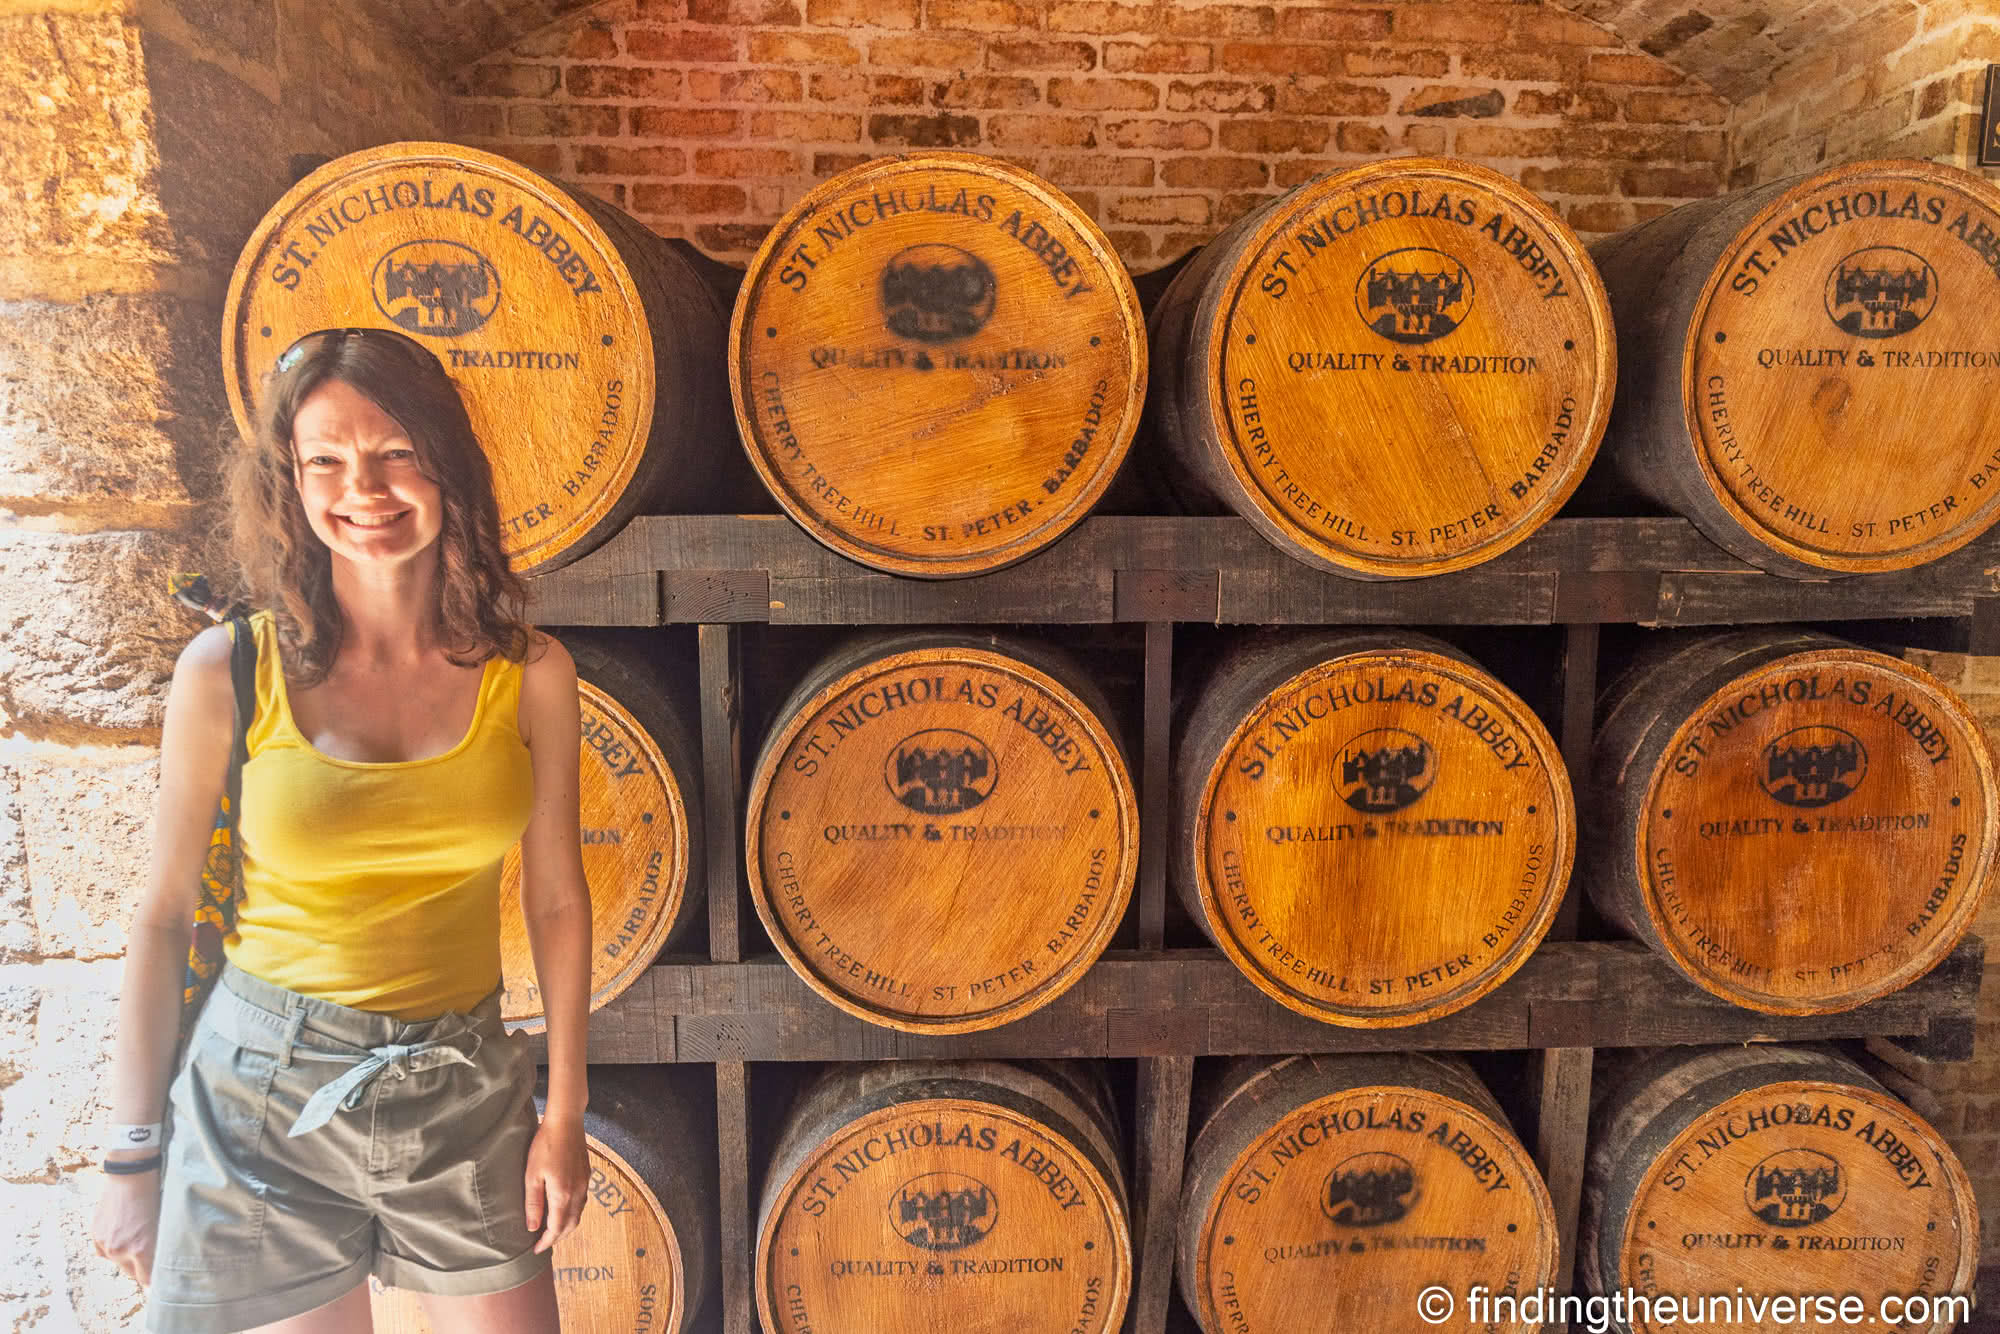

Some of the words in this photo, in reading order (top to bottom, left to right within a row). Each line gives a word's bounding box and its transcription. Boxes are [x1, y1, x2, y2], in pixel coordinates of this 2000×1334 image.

[271, 239, 317, 292] ST.
[306, 180, 496, 247] NICHOLAS
[500, 205, 603, 298] ABBEY
[815, 185, 996, 252] NICHOLAS
[1000, 210, 1096, 299] ABBEY
[1301, 192, 1476, 258] NICHOLAS
[1480, 216, 1569, 301] ABBEY
[1732, 248, 1777, 297] ST.
[1774, 191, 1945, 258] NICHOLAS
[447, 348, 579, 370] TRADITION
[1288, 353, 1384, 373] QUALITY
[1392, 354, 1411, 371] &
[1417, 354, 1539, 375] TRADITION
[1757, 348, 1849, 369] QUALITY
[1856, 350, 1875, 369] &
[1882, 351, 2000, 369] TRADITION
[500, 501, 554, 539] TER
[563, 379, 624, 499] BARBADOS
[760, 371, 806, 463] CHERRY
[800, 463, 859, 514] TREE
[962, 499, 1032, 538] PETER
[1042, 378, 1108, 495] BARBADOS
[1239, 378, 1280, 470] CHERRY
[1275, 469, 1320, 519] TREE
[1322, 512, 1369, 543] HILL
[1391, 530, 1420, 546] ST.
[1430, 503, 1503, 544] PETER
[1509, 390, 1577, 500] BARBADO
[1708, 375, 1745, 466] CHERRY
[1739, 464, 1786, 512] TREE
[1783, 504, 1830, 535] HILL
[1888, 494, 1959, 536] PETER
[794, 737, 837, 778] ST.
[827, 677, 999, 741] NICHOLAS
[1001, 700, 1092, 776] ABBEY
[1271, 679, 1440, 742] NICHOLAS
[1441, 695, 1530, 772] ABBEY
[1707, 676, 1872, 738] NICHOLAS
[1873, 691, 1952, 766] ABBEY
[824, 824, 918, 845] QUALITY
[923, 825, 941, 842] &
[1266, 825, 1357, 845] QUALITY
[1363, 822, 1379, 840] &
[1384, 819, 1504, 840] TRADITION
[1701, 818, 1784, 840] QUALITY
[1792, 819, 1809, 832] &
[1817, 814, 1929, 833] TRADITION
[604, 850, 663, 959] BARBADOS
[778, 851, 820, 935] CHERRY
[815, 933, 861, 978] TREE
[865, 971, 911, 997] HILL
[970, 960, 1038, 998] PETER
[1047, 848, 1106, 954] BARBADOS
[1223, 850, 1261, 934] CHERRY
[1258, 931, 1302, 973] TREE
[1306, 967, 1349, 992] HILL
[1406, 954, 1474, 995] PETER
[1483, 843, 1543, 950] BARBADOS
[1656, 848, 1691, 926] CHERRY
[1688, 925, 1731, 967] TREE
[1907, 833, 1966, 938] BARBADOS
[803, 1177, 842, 1217] ST.
[833, 1123, 997, 1179] NICHOLAS
[1000, 1140, 1087, 1212] ABBEY
[1237, 1171, 1277, 1205] ST.
[1271, 1106, 1426, 1168] NICHOLAS
[1428, 1123, 1510, 1194] ABBEY
[1664, 1154, 1703, 1192] ST.
[1696, 1104, 1854, 1160] NICHOLAS
[1856, 1121, 1932, 1190] ABBEY
[831, 1261, 919, 1280] QUALITY
[927, 1260, 944, 1274] &
[952, 1256, 1063, 1275] TRADITION
[1264, 1239, 1343, 1263] QUALITY
[1682, 1233, 1766, 1250] QUALITY
[1771, 1235, 1790, 1250] &
[1798, 1235, 1906, 1251] TRADITION
